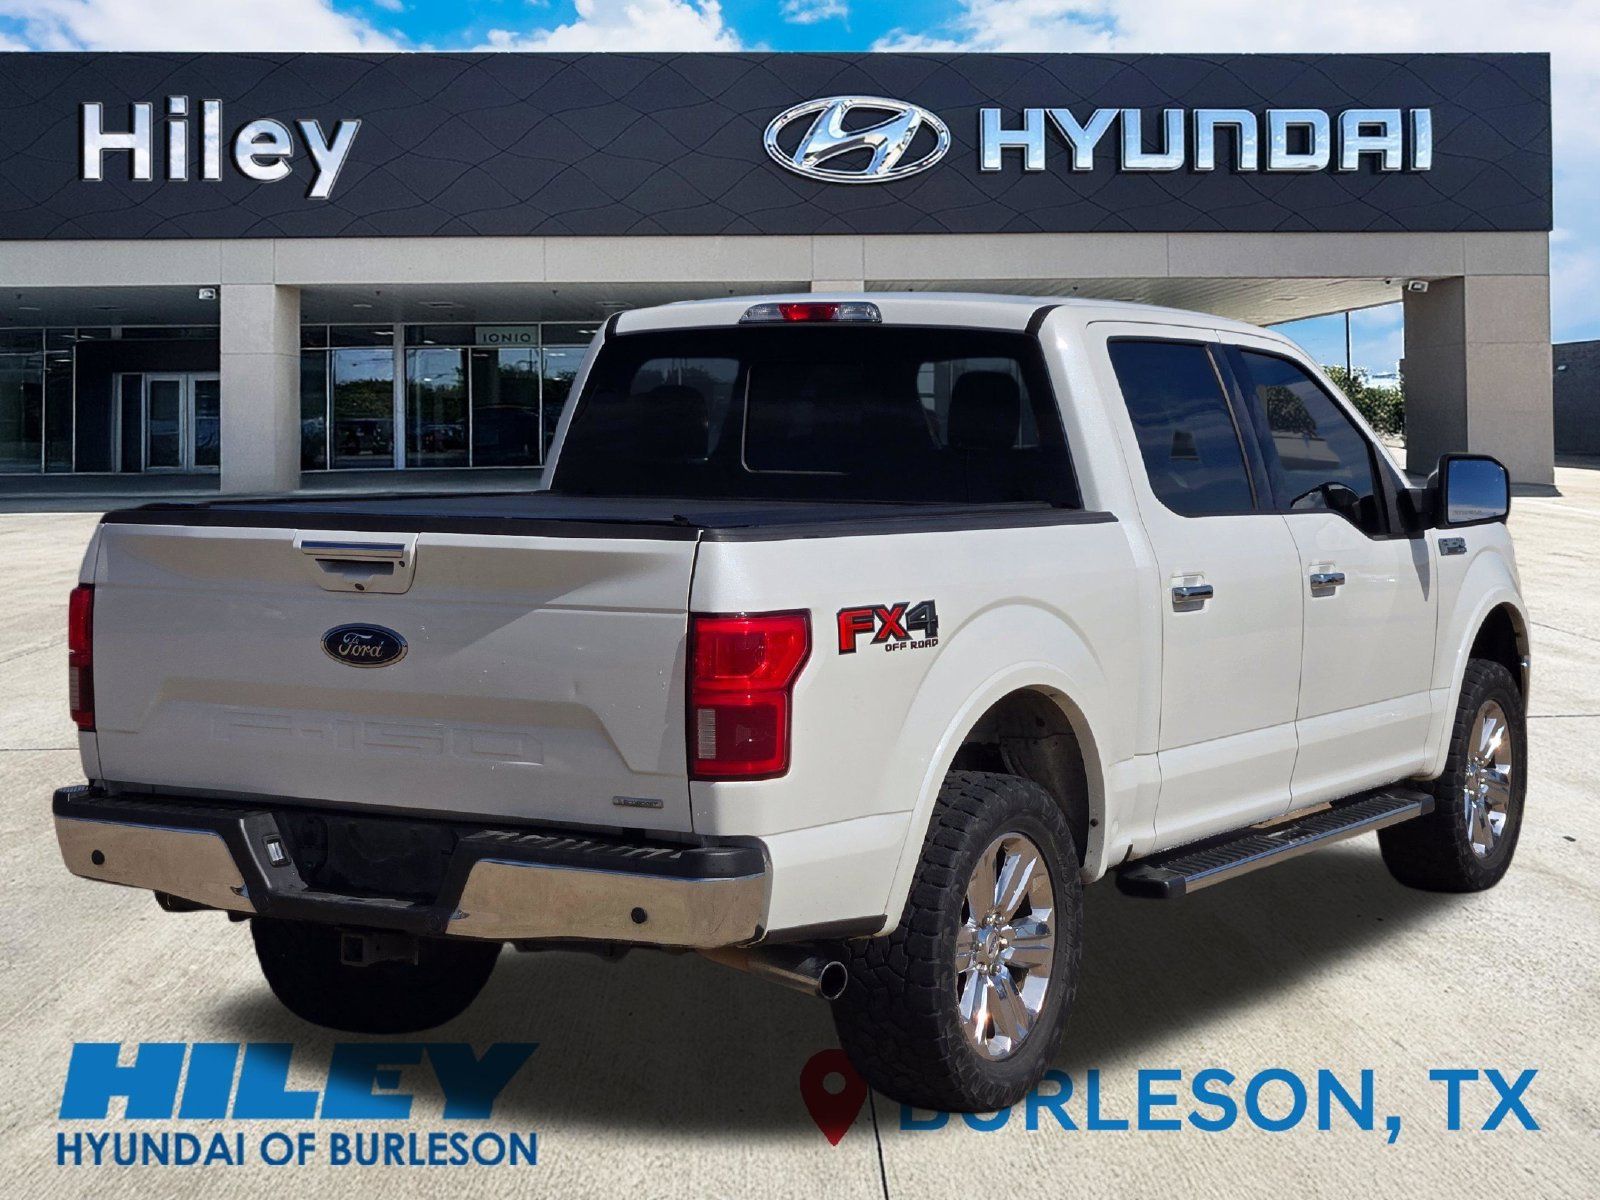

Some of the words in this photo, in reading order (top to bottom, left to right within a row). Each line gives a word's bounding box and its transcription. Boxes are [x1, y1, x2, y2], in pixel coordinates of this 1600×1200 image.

[81, 95, 361, 200] Hiley
[980, 108, 1433, 171] HYUNDAI
[338, 632, 384, 657] Ford
[836, 599, 939, 655] FX4
[885, 642, 907, 652] OFF
[910, 639, 939, 650] ROAD
